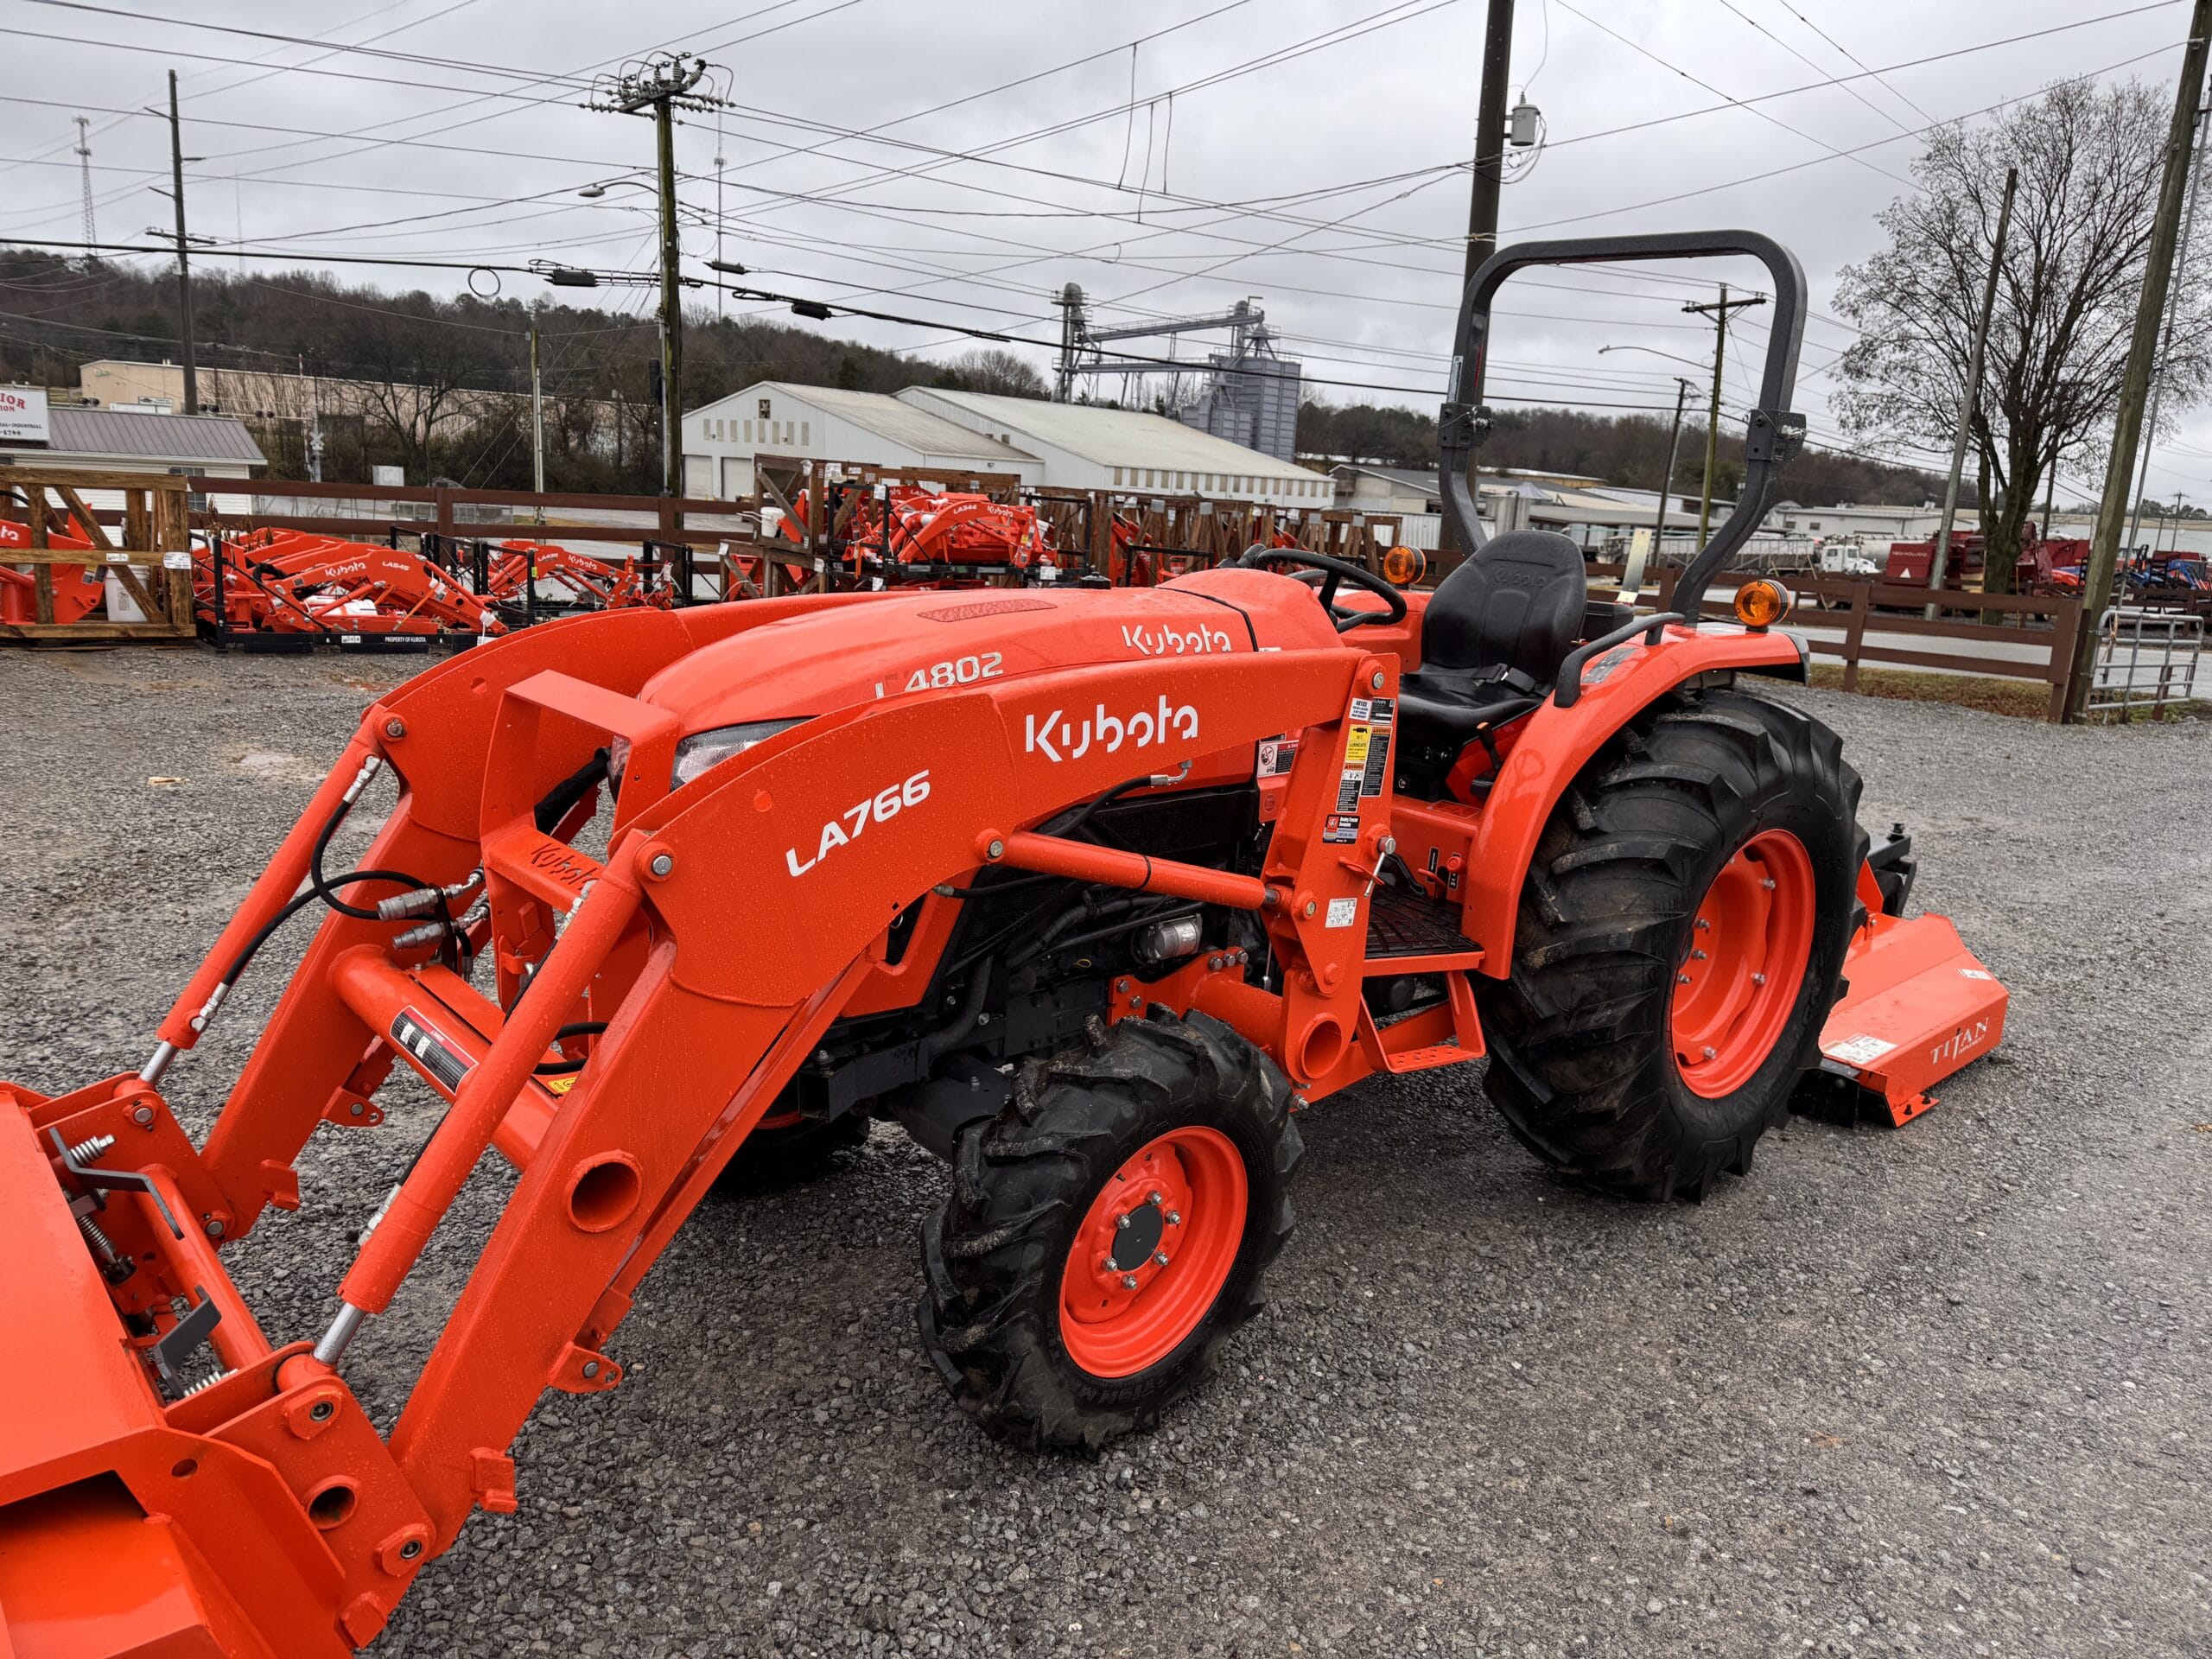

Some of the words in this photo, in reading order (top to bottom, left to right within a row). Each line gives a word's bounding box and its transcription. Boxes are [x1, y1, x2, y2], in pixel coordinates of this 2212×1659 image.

[987, 505, 1014, 518] Kubota
[324, 562, 367, 577] Kubota
[568, 554, 598, 570] Kubota
[1122, 623, 1232, 655] Kubota
[1025, 694, 1199, 762] Kubota
[785, 769, 931, 878] LA766
[1929, 1016, 1989, 1065] TITAN
